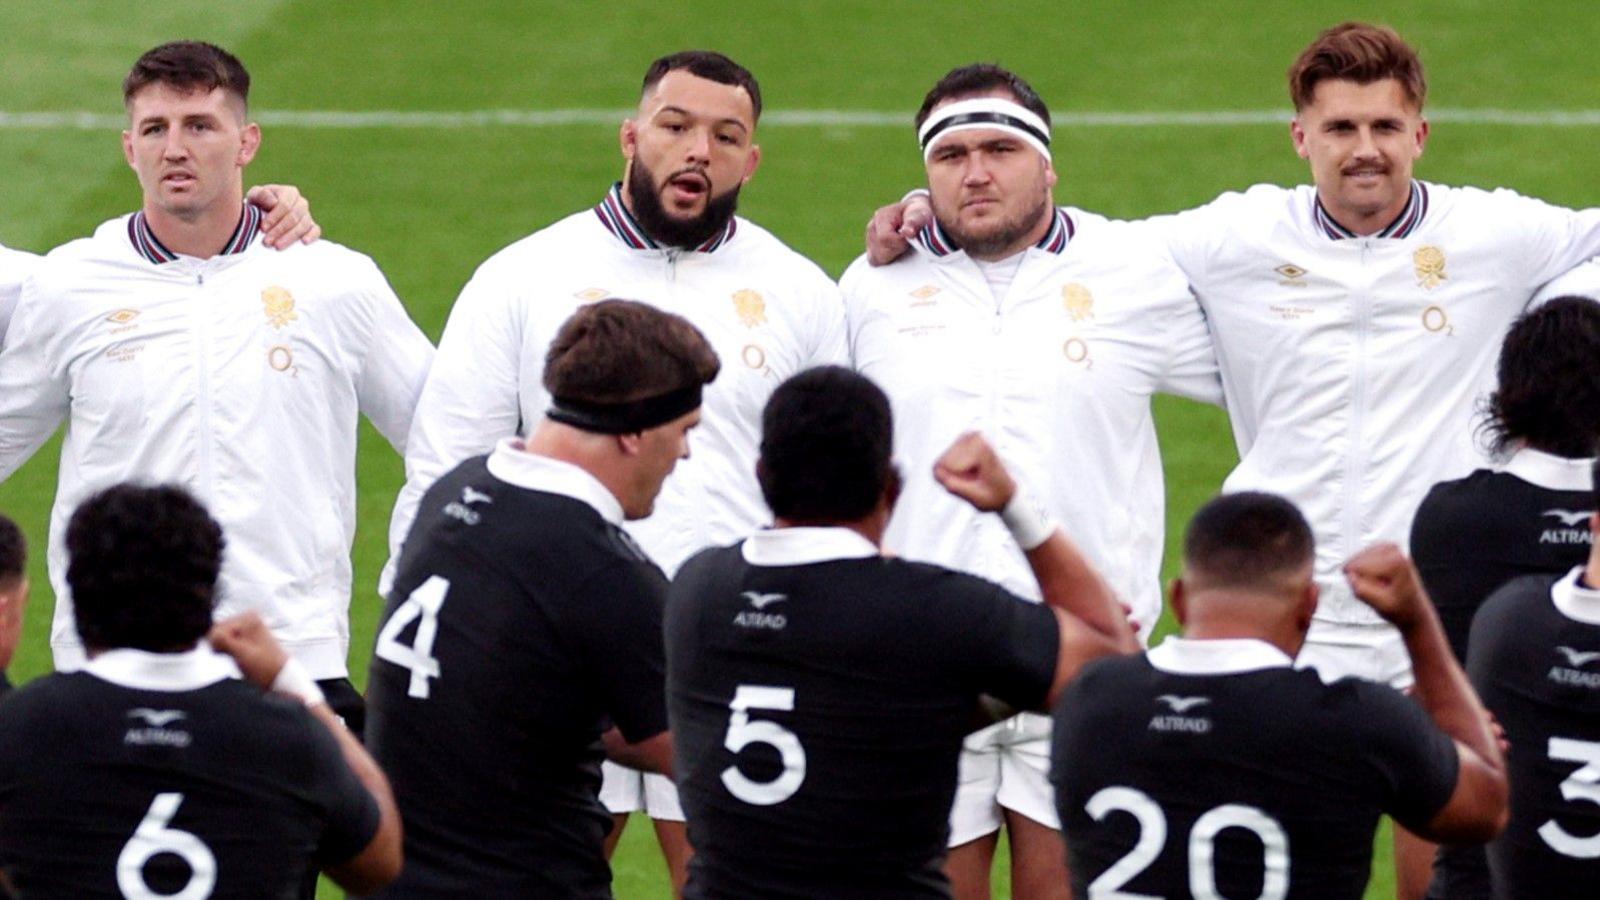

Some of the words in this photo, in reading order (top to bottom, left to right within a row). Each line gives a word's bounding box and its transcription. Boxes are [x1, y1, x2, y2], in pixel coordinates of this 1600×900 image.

[1539, 529, 1594, 544] ALTRA
[375, 574, 450, 699] 4
[721, 685, 806, 805] 5
[1148, 715, 1212, 733] ALTRAD
[117, 793, 215, 900] 6
[1084, 786, 1290, 900] 20
[1537, 736, 1600, 858] 3
